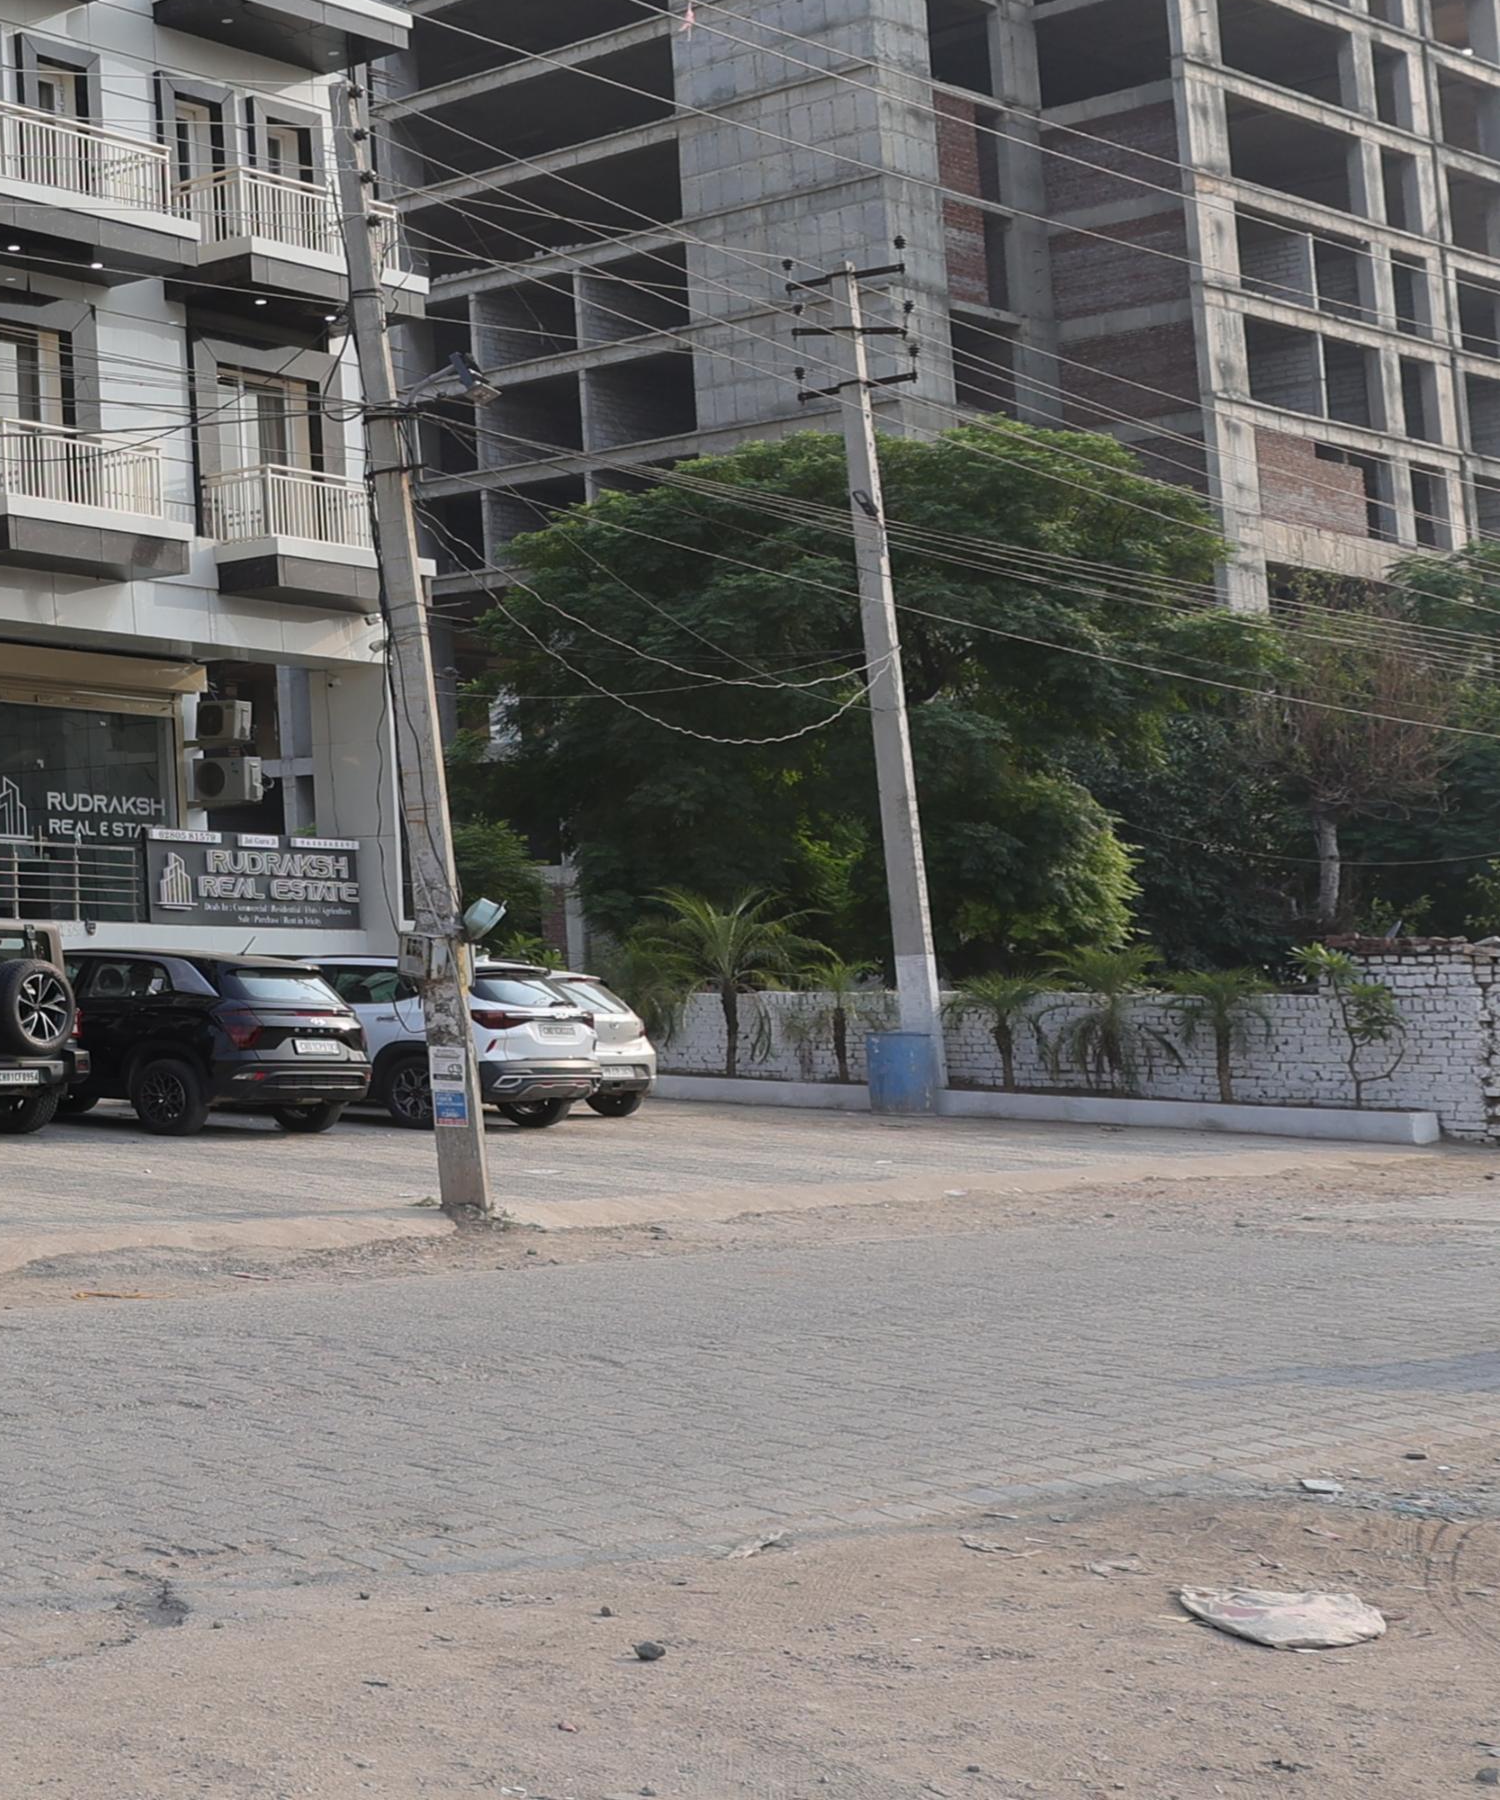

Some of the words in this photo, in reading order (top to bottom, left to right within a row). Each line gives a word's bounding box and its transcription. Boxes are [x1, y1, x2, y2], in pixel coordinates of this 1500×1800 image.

[47, 791, 167, 816] RUDRAKSH
[49, 818, 97, 837] REAL
[206, 849, 349, 879] RUDRAKSH
[199, 875, 266, 900] REAL
[270, 879, 361, 903] ESTATE
